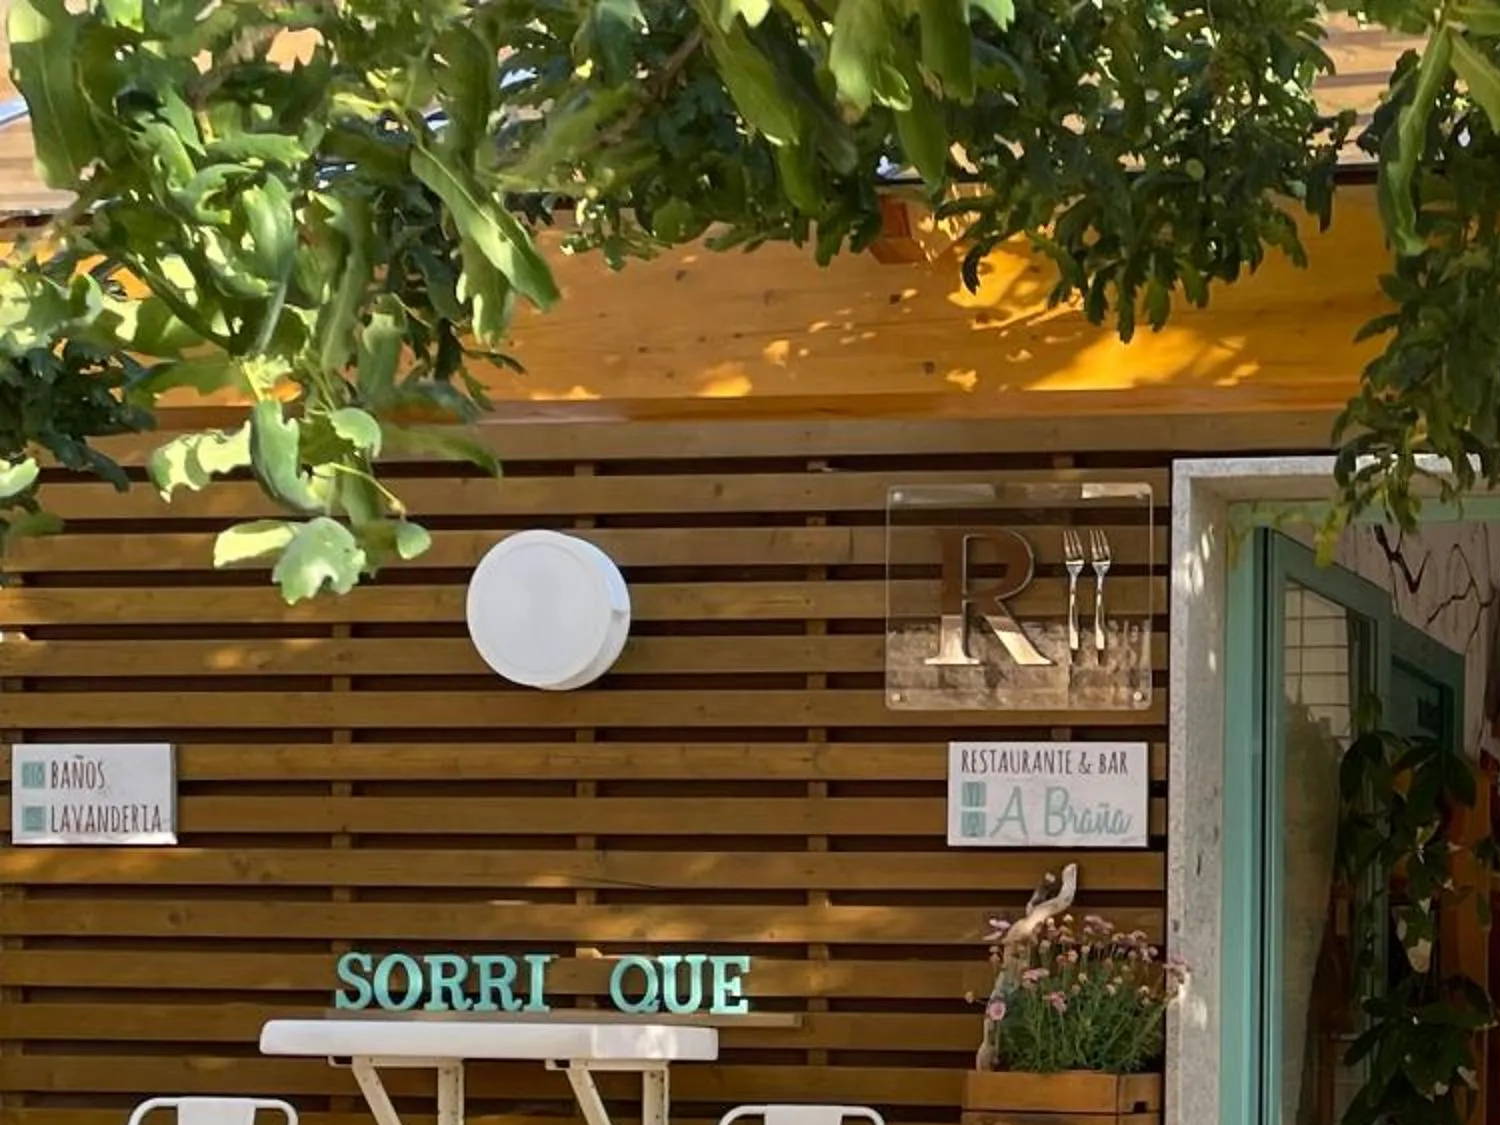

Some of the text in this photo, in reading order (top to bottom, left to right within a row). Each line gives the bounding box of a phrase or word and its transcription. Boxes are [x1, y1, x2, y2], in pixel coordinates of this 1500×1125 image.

[51, 754, 105, 789] BAÑOS
[961, 750, 1128, 775] RESTAURANTE & BAR
[51, 804, 162, 833] LAVANDERIA
[989, 786, 1132, 837] A Braña
[335, 952, 751, 1015] SORRI QUE
